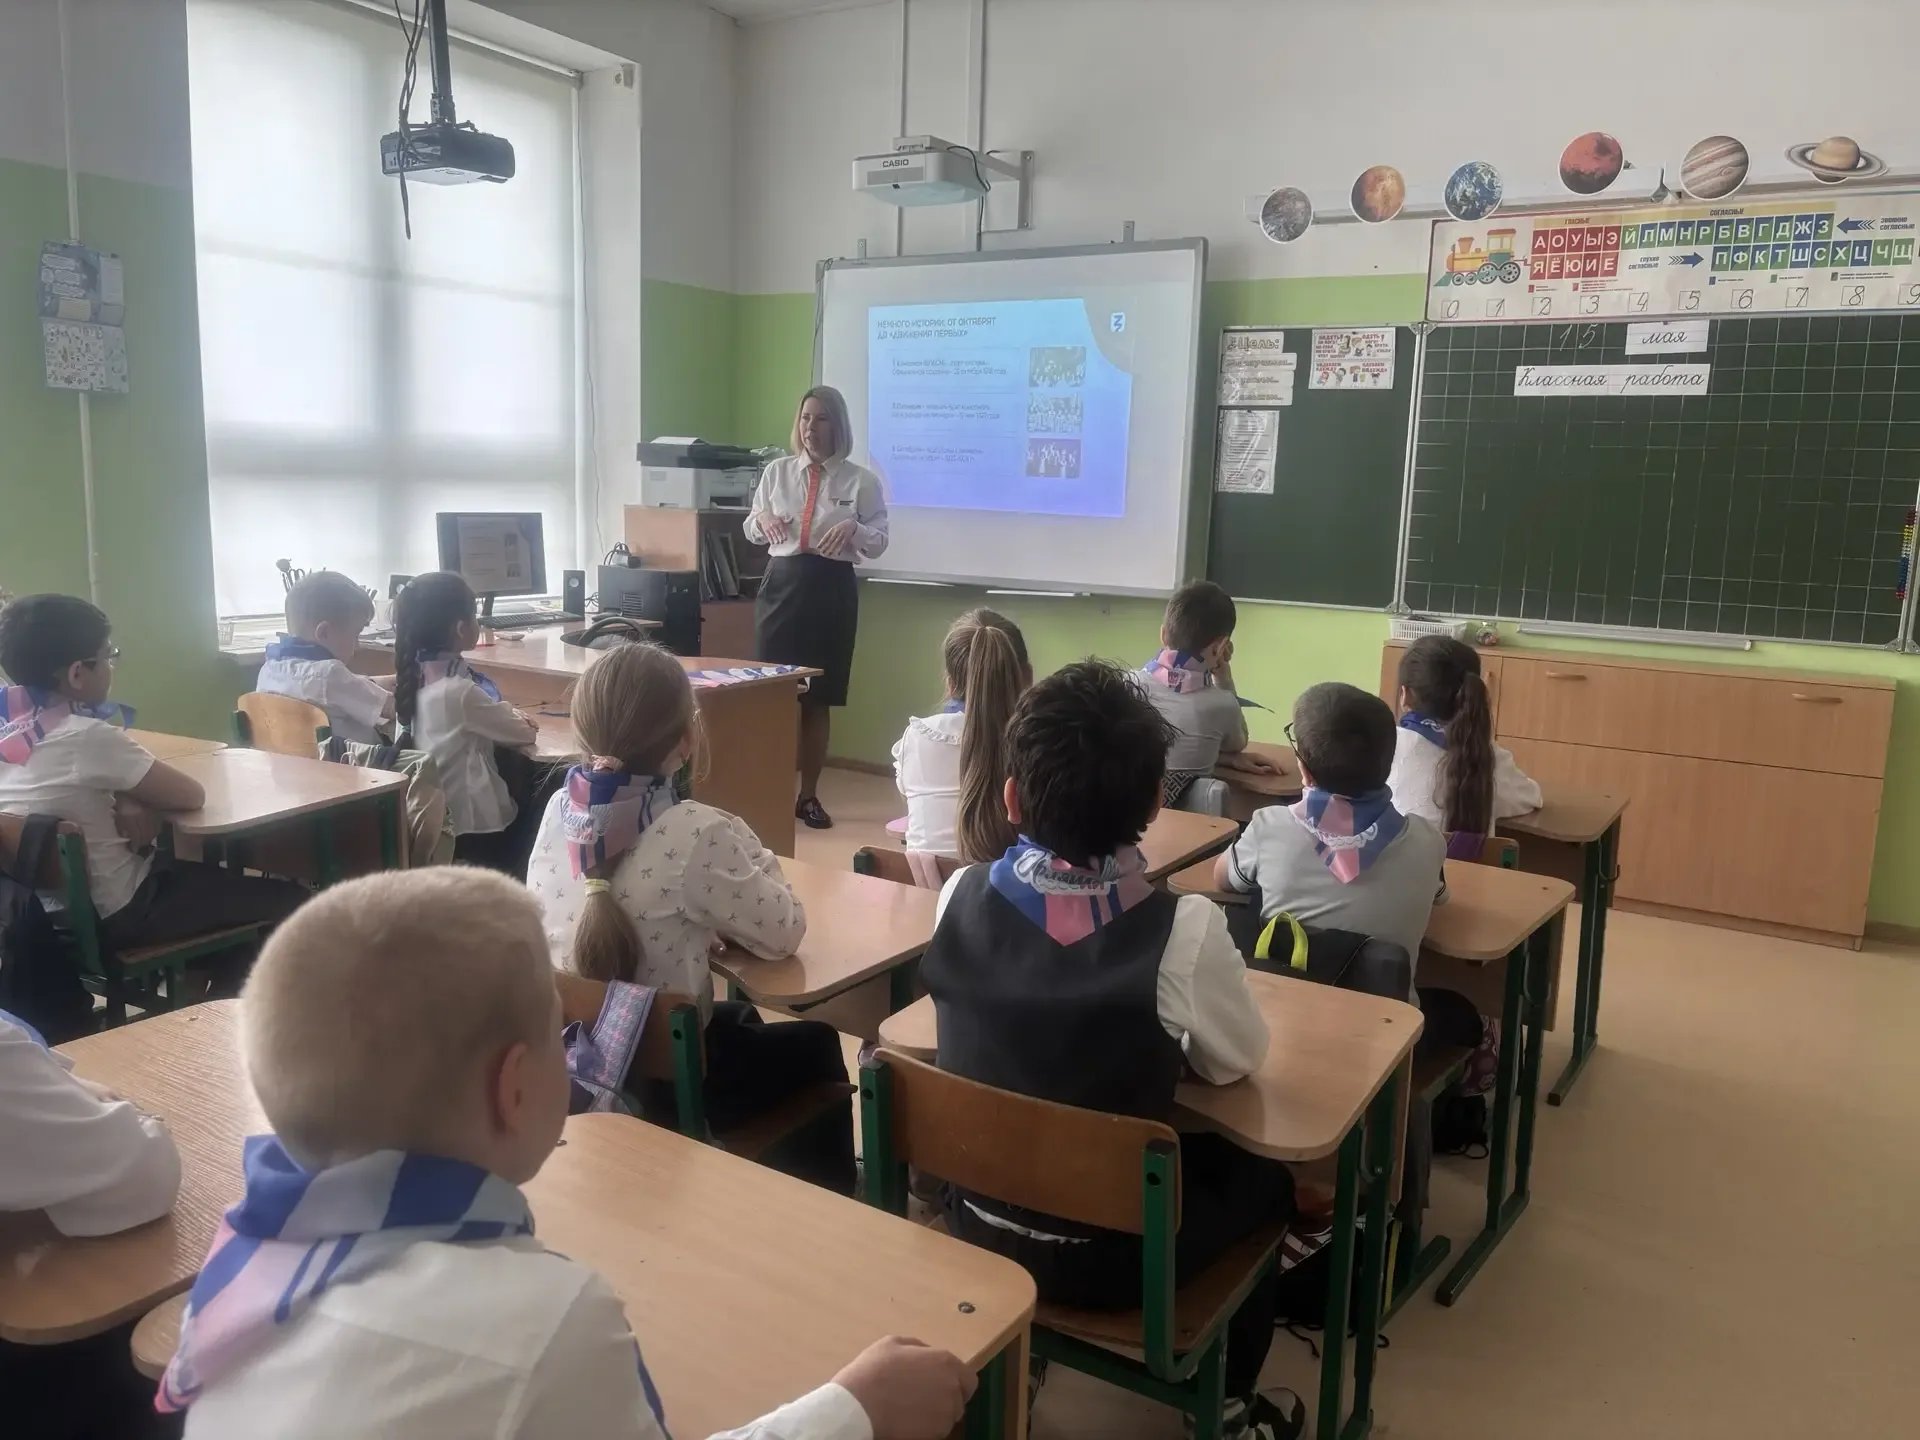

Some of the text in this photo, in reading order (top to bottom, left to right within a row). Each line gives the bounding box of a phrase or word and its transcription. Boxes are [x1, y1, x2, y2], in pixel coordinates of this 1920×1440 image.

[883, 158, 909, 168] CASIO
[1446, 283, 1920, 318] 0 1 2 3 4 5 6 7 8 9
[947, 317, 958, 327] ОТ
[959, 316, 997, 326] ОКТЯБРЯТ
[877, 331, 888, 340] ДО
[1642, 330, 1687, 345] мая
[1238, 336, 1281, 352] Цель:
[1517, 364, 1705, 394] Классная работа
